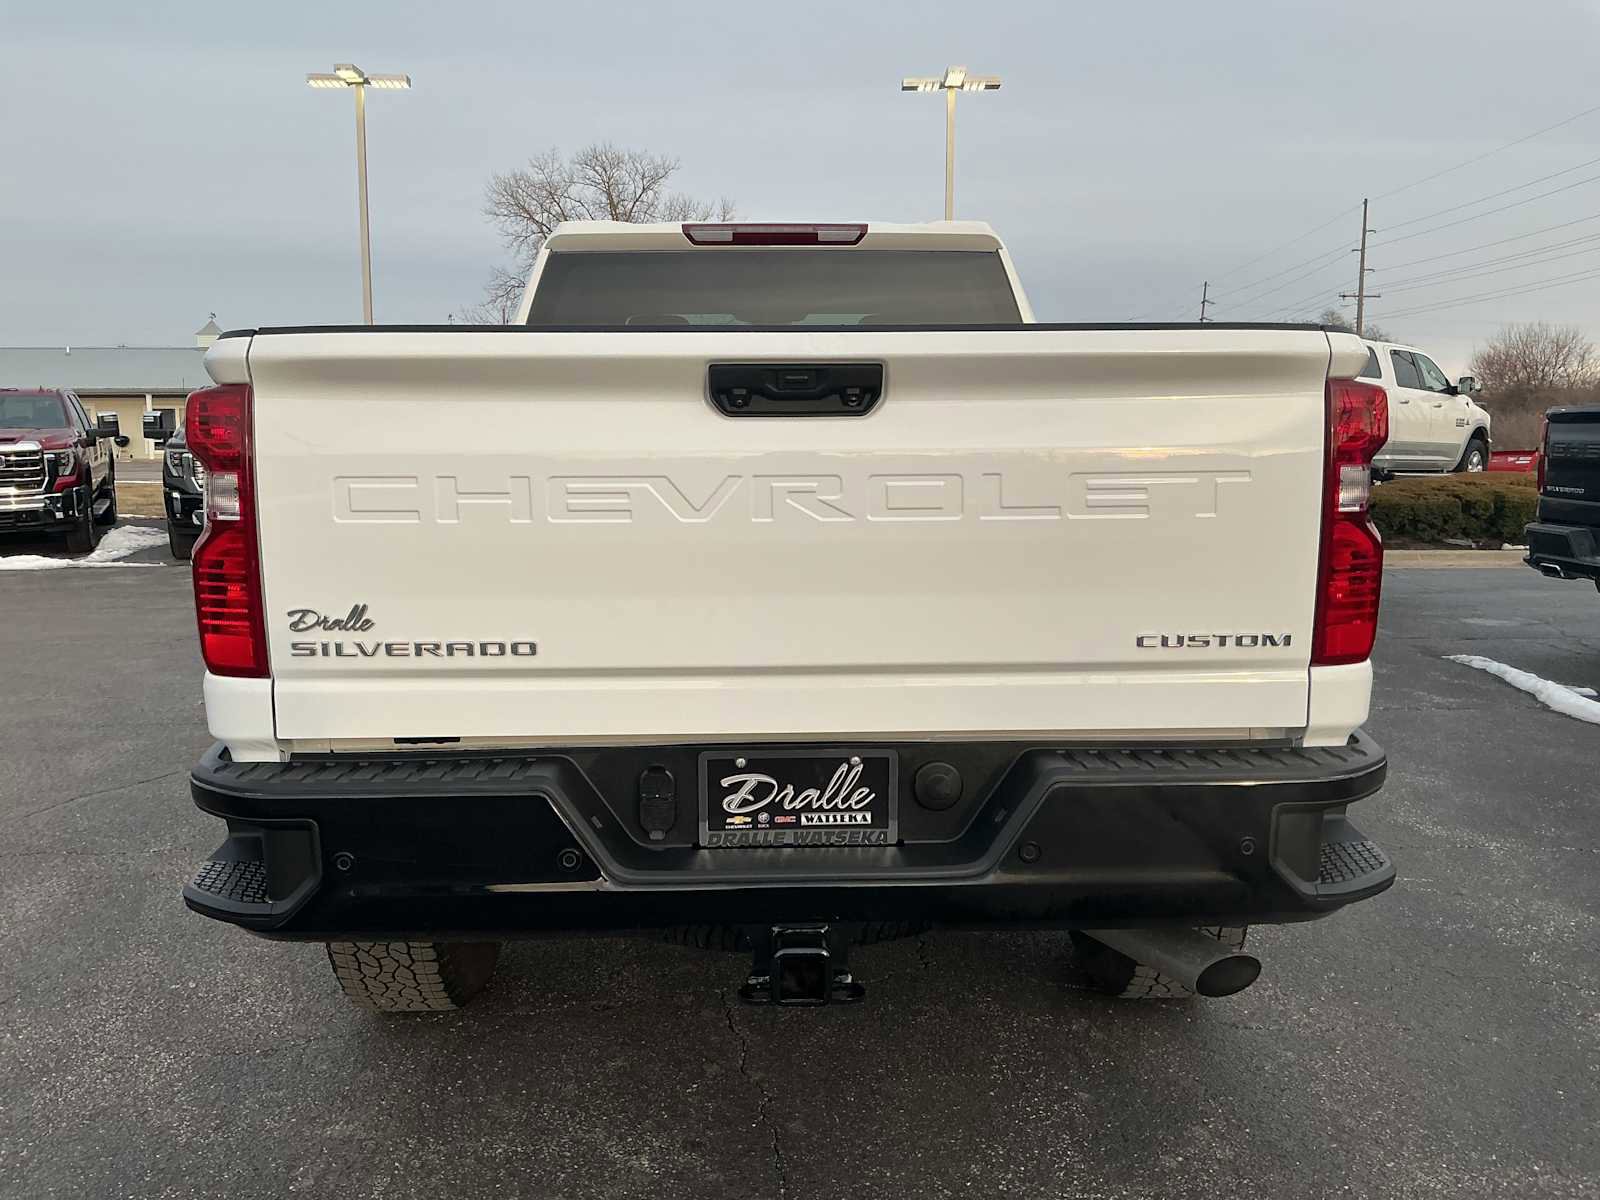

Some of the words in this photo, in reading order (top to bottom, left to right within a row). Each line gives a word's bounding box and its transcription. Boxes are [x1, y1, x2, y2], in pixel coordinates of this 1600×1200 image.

[333, 470, 1253, 524] CHEVROLET
[287, 604, 375, 632] Dralle
[291, 641, 538, 657] SILVERADO
[1136, 634, 1292, 648] CUSTOM
[720, 762, 876, 814] Dralle
[774, 815, 797, 823] GMC
[804, 812, 869, 824] WATSEKA
[707, 831, 786, 847] DRALLE
[791, 831, 888, 845] WATSEKA
